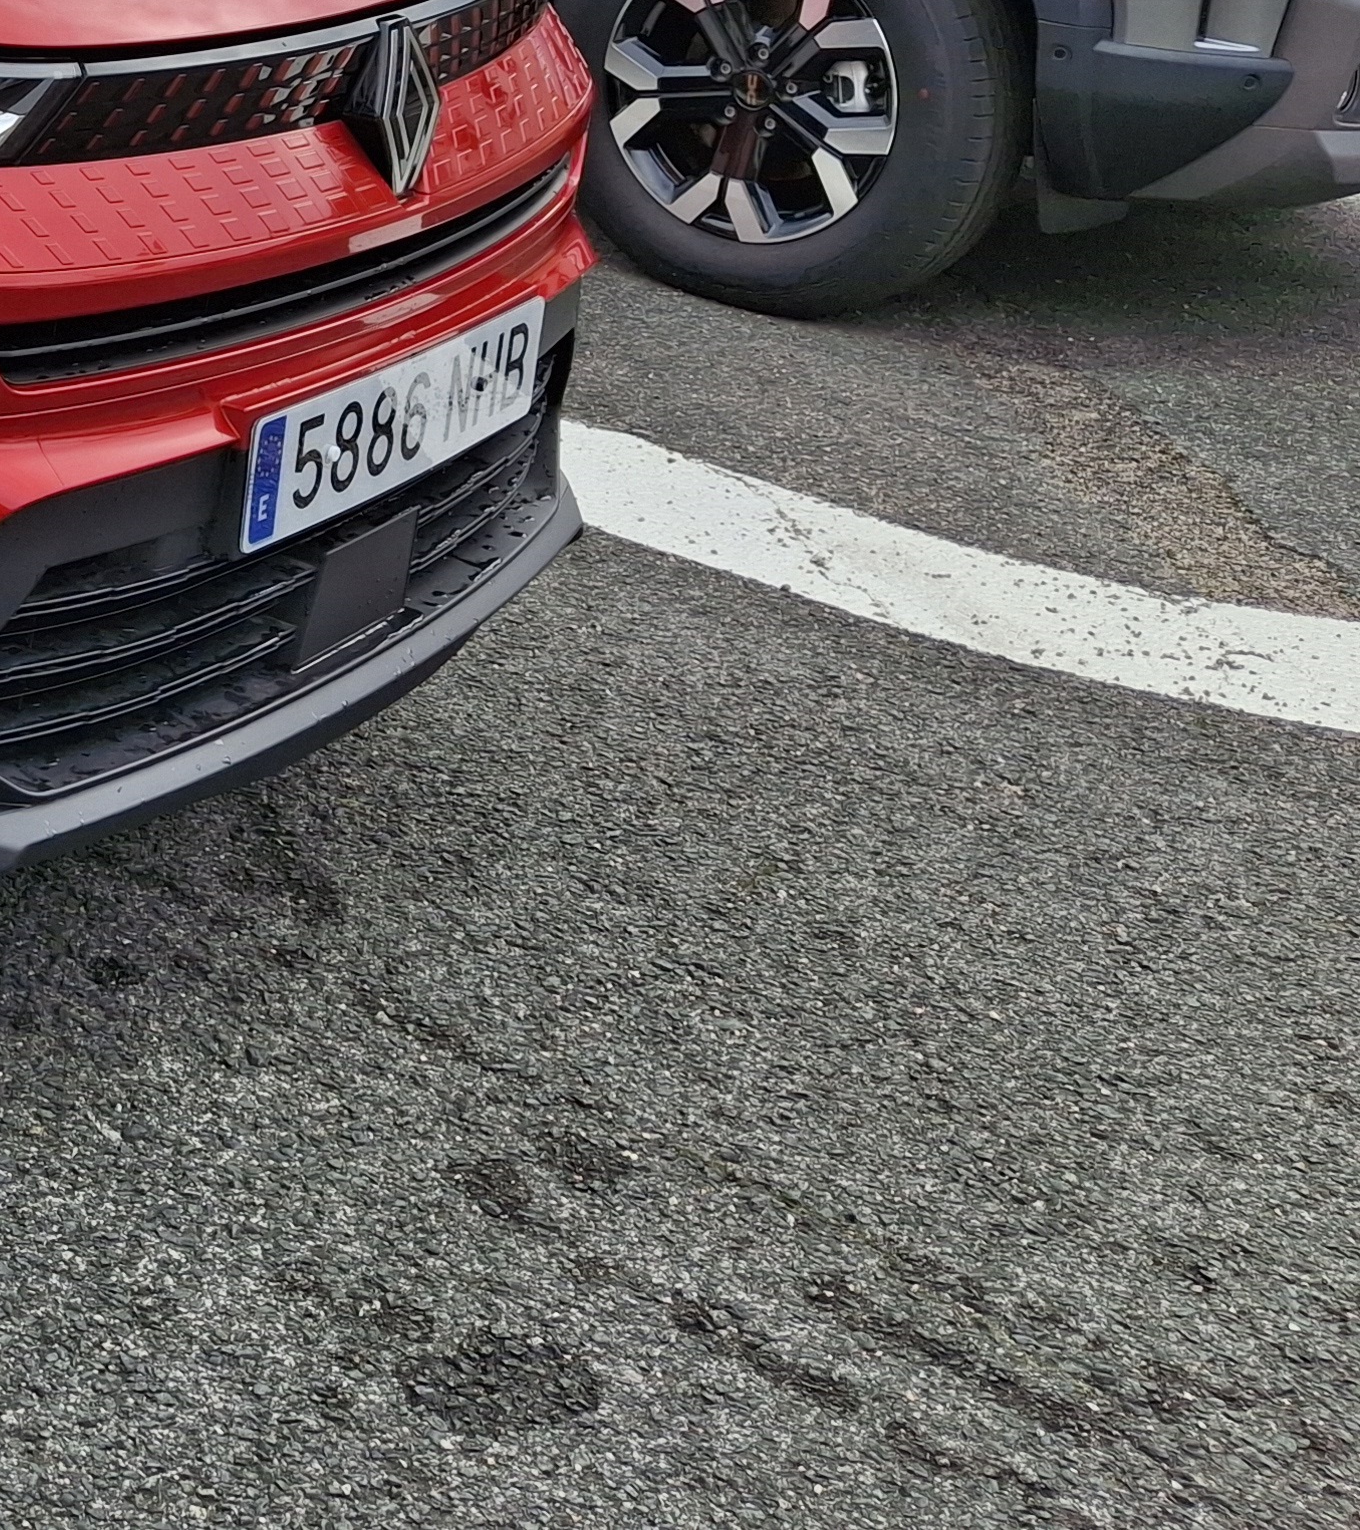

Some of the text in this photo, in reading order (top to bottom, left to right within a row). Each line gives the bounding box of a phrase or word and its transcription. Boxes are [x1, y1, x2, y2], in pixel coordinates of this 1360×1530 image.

[292, 322, 529, 510] 5886 NHB
[257, 493, 270, 522] E
